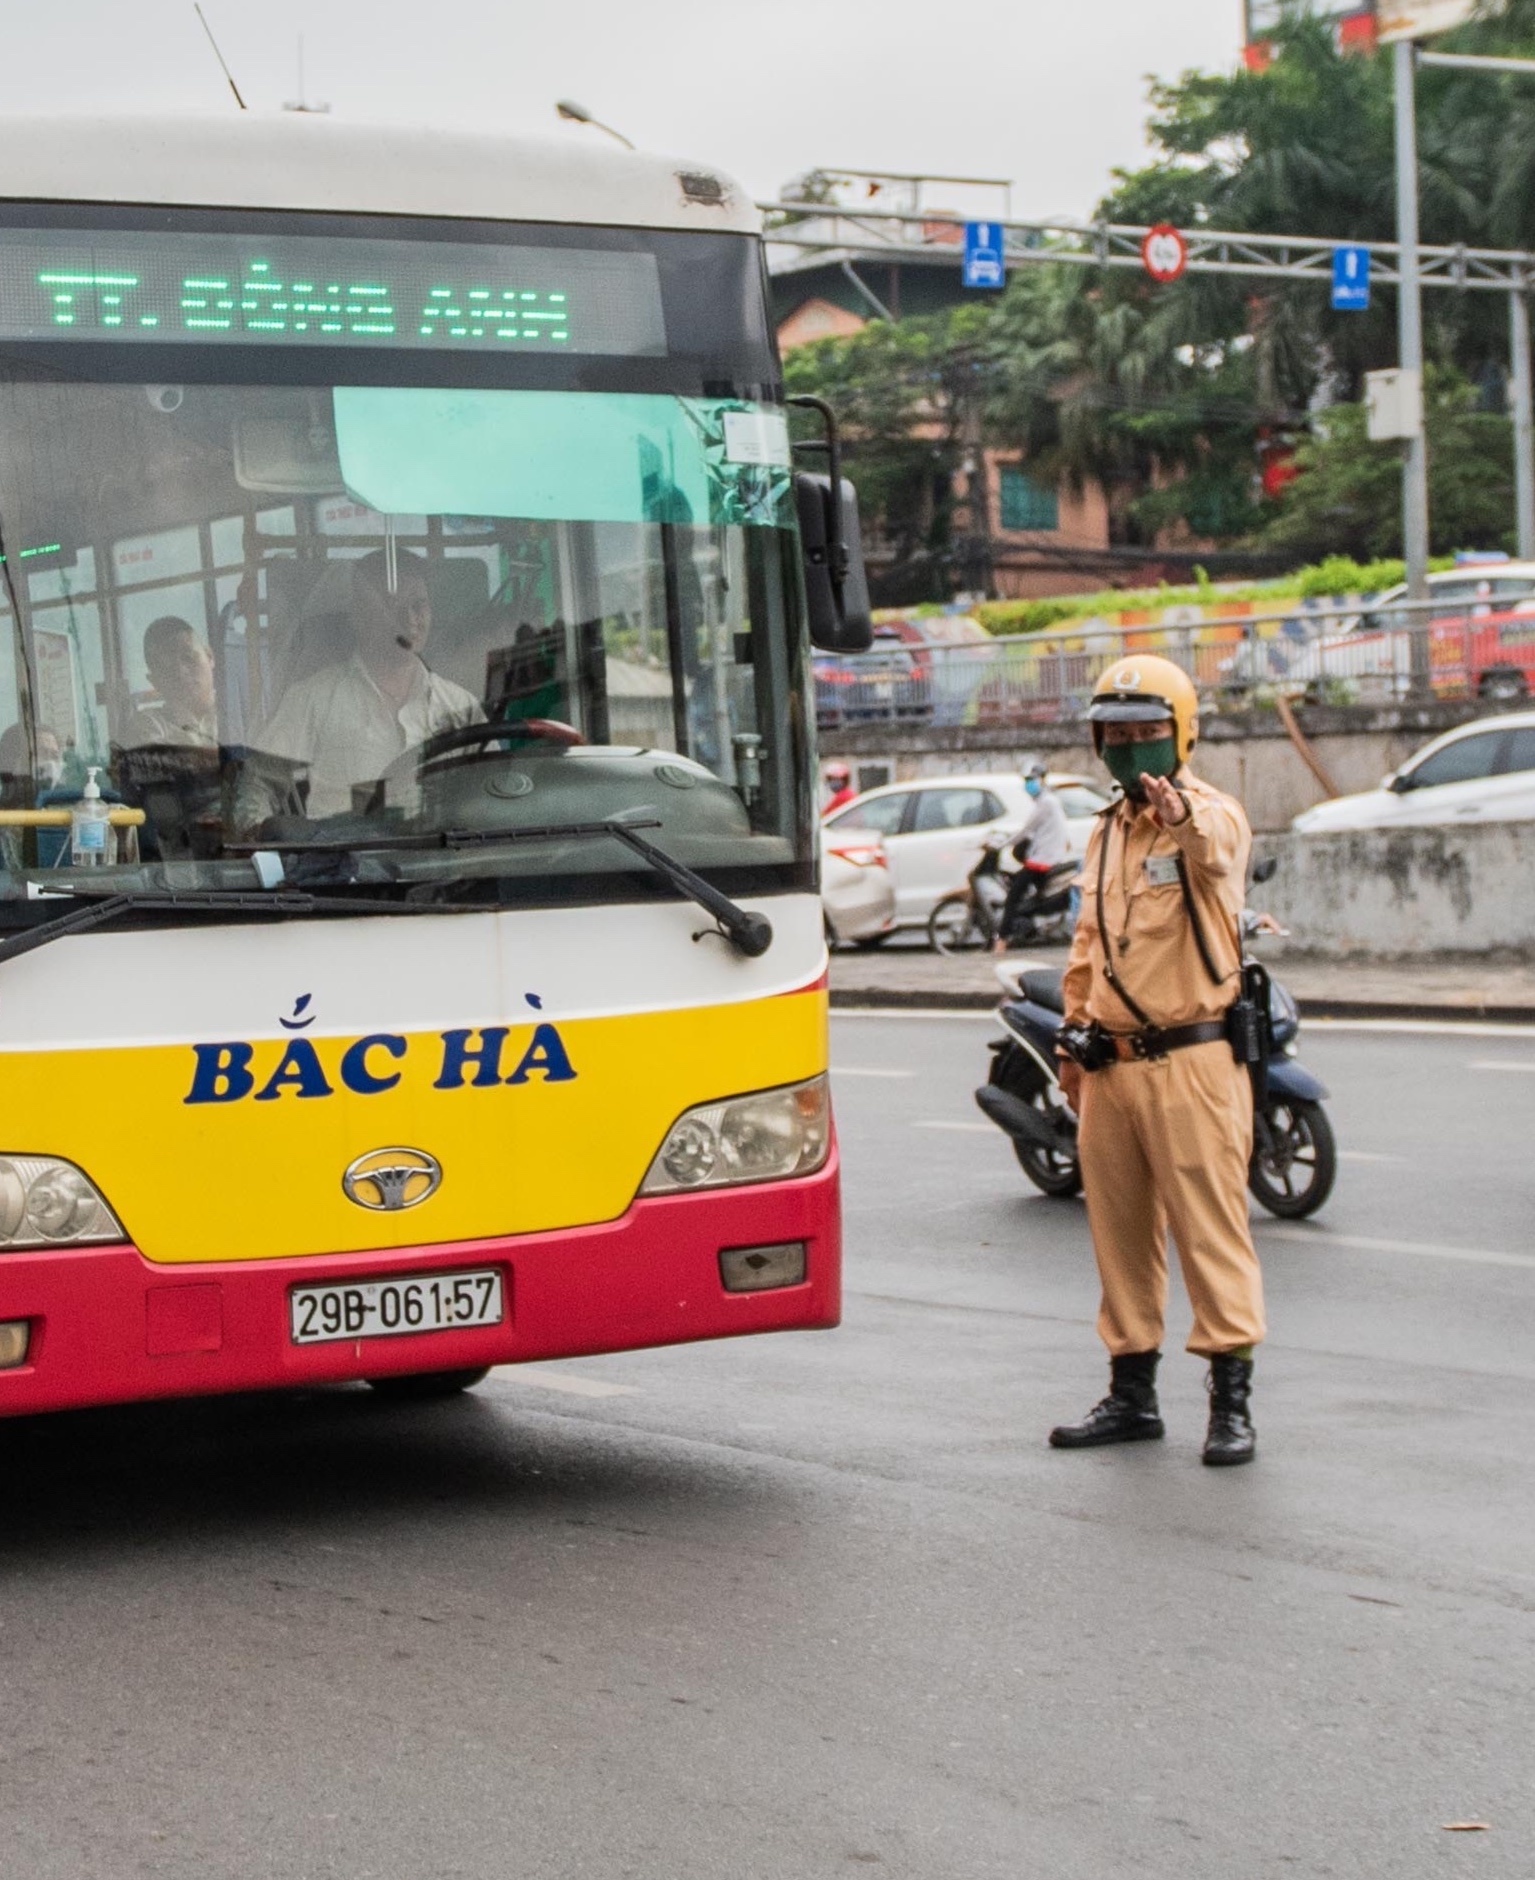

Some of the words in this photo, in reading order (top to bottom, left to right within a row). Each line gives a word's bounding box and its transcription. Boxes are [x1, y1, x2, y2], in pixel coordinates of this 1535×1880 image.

[39, 274, 158, 326] TT.
[420, 290, 569, 339] ANH
[183, 993, 408, 1104] BẮC
[432, 993, 578, 1090] HÀ
